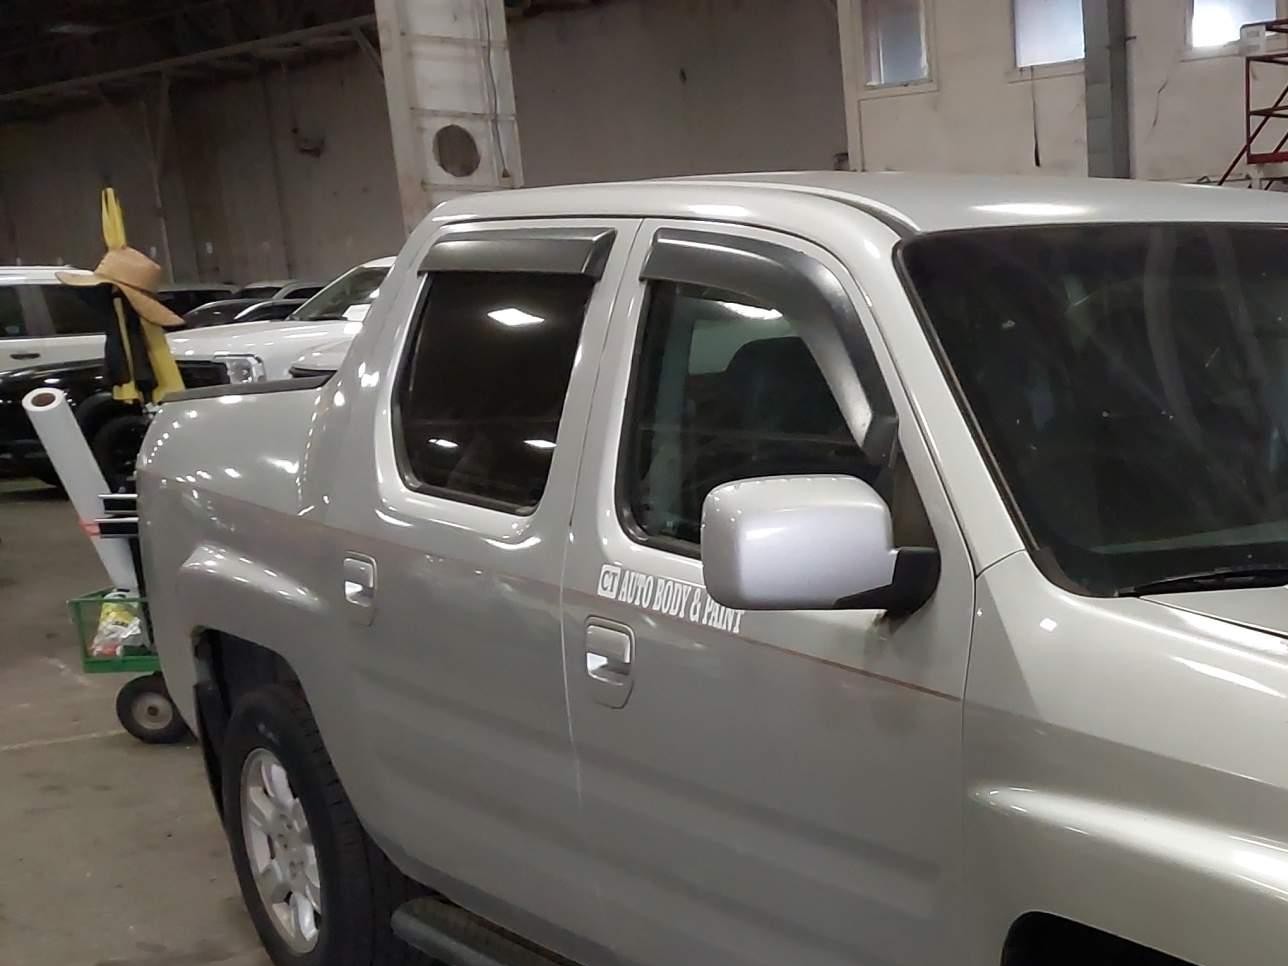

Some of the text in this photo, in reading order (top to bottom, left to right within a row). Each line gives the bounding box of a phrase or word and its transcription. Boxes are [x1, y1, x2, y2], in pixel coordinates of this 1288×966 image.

[618, 569, 654, 609] AUTO
[652, 577, 692, 619] BODY
[689, 587, 701, 623] &
